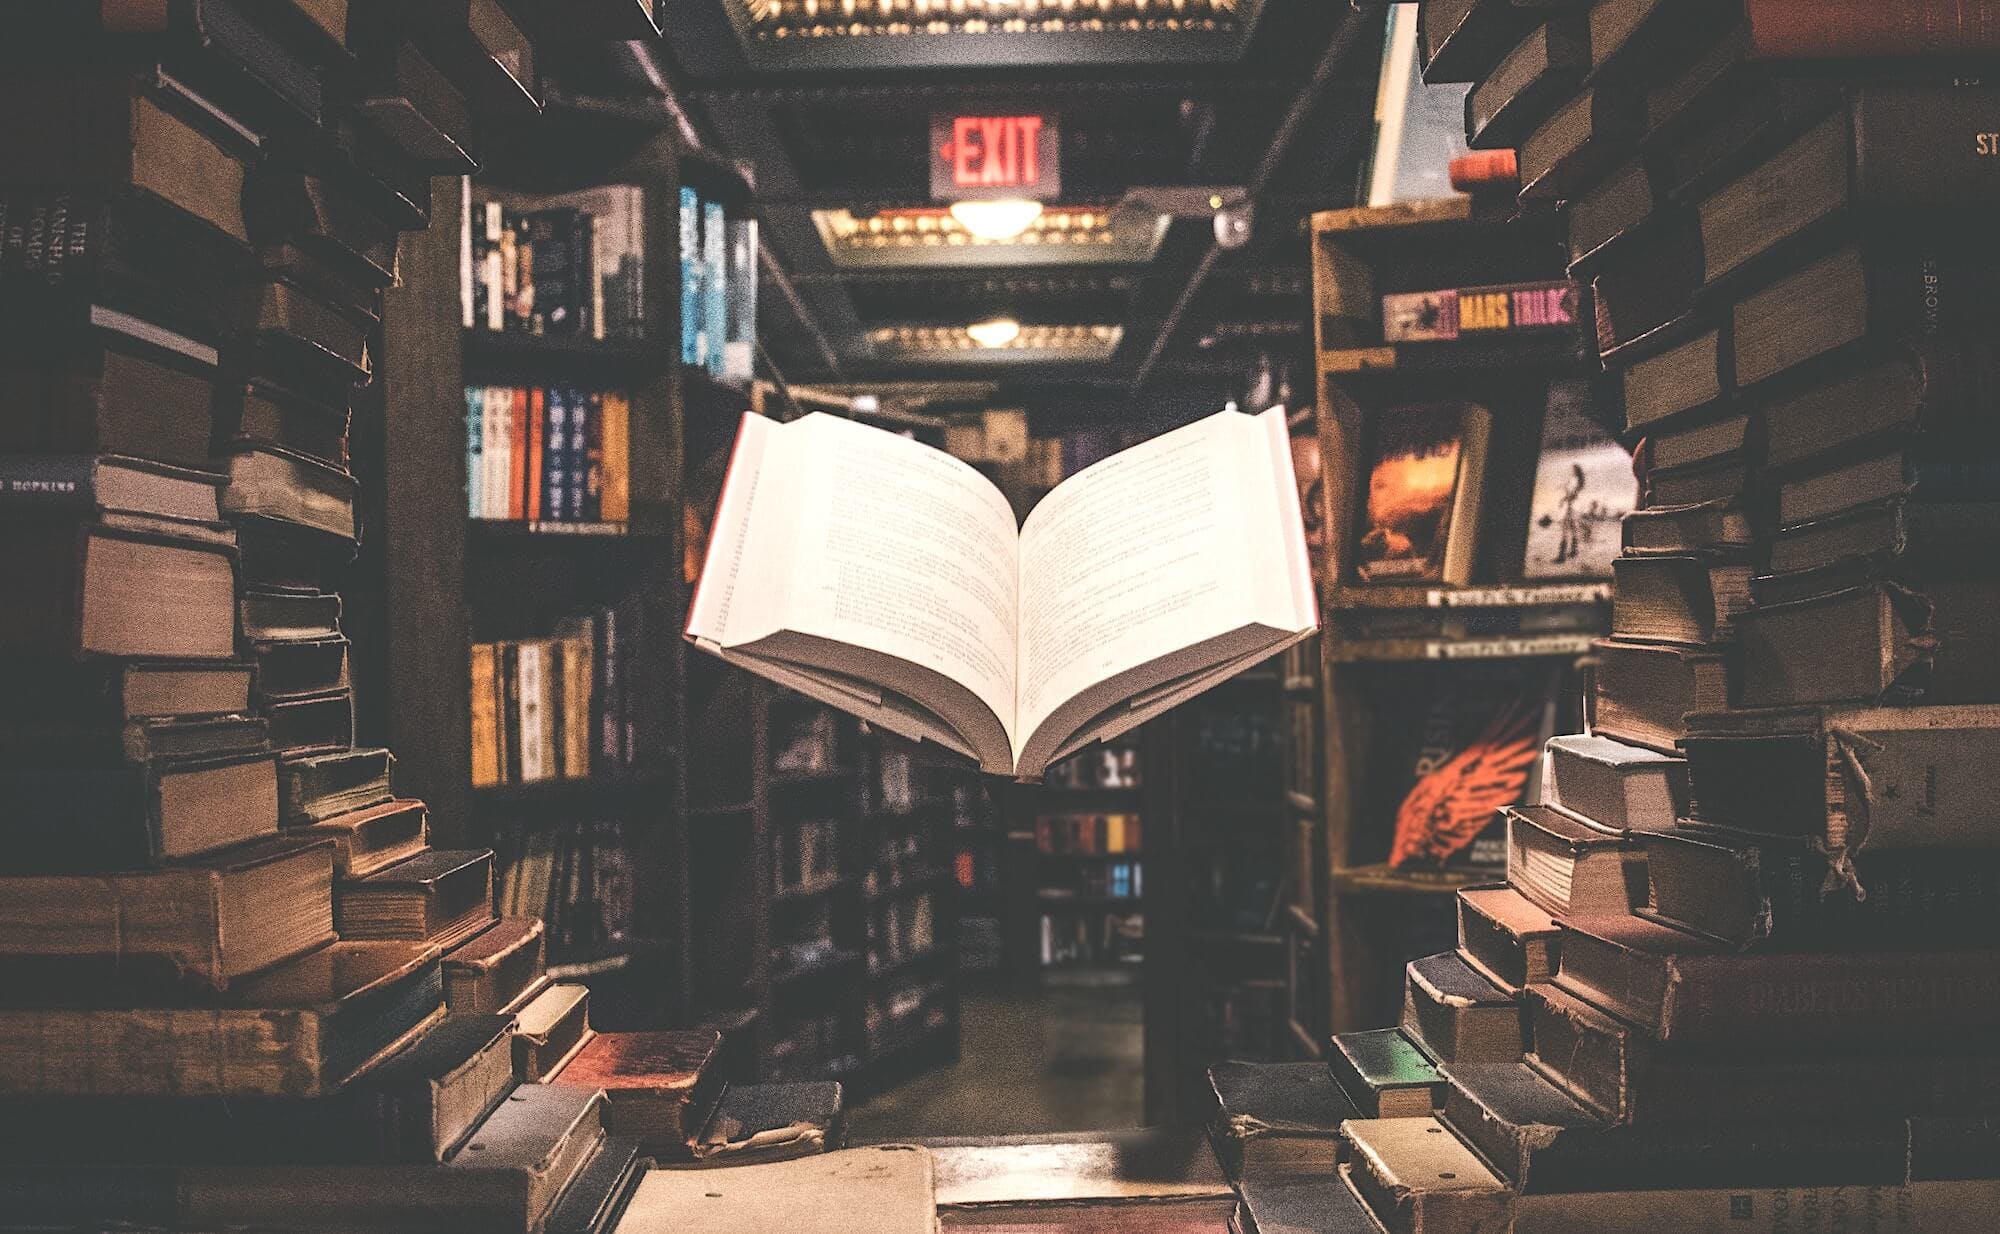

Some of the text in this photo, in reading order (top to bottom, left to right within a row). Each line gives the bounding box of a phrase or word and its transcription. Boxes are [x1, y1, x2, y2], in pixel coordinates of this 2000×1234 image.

[954, 116, 1041, 184] EXIT
[9, 226, 24, 248] OF
[70, 222, 88, 256] THE
[1459, 293, 1509, 330] MARS
[12, 480, 75, 492] HOPKINS
